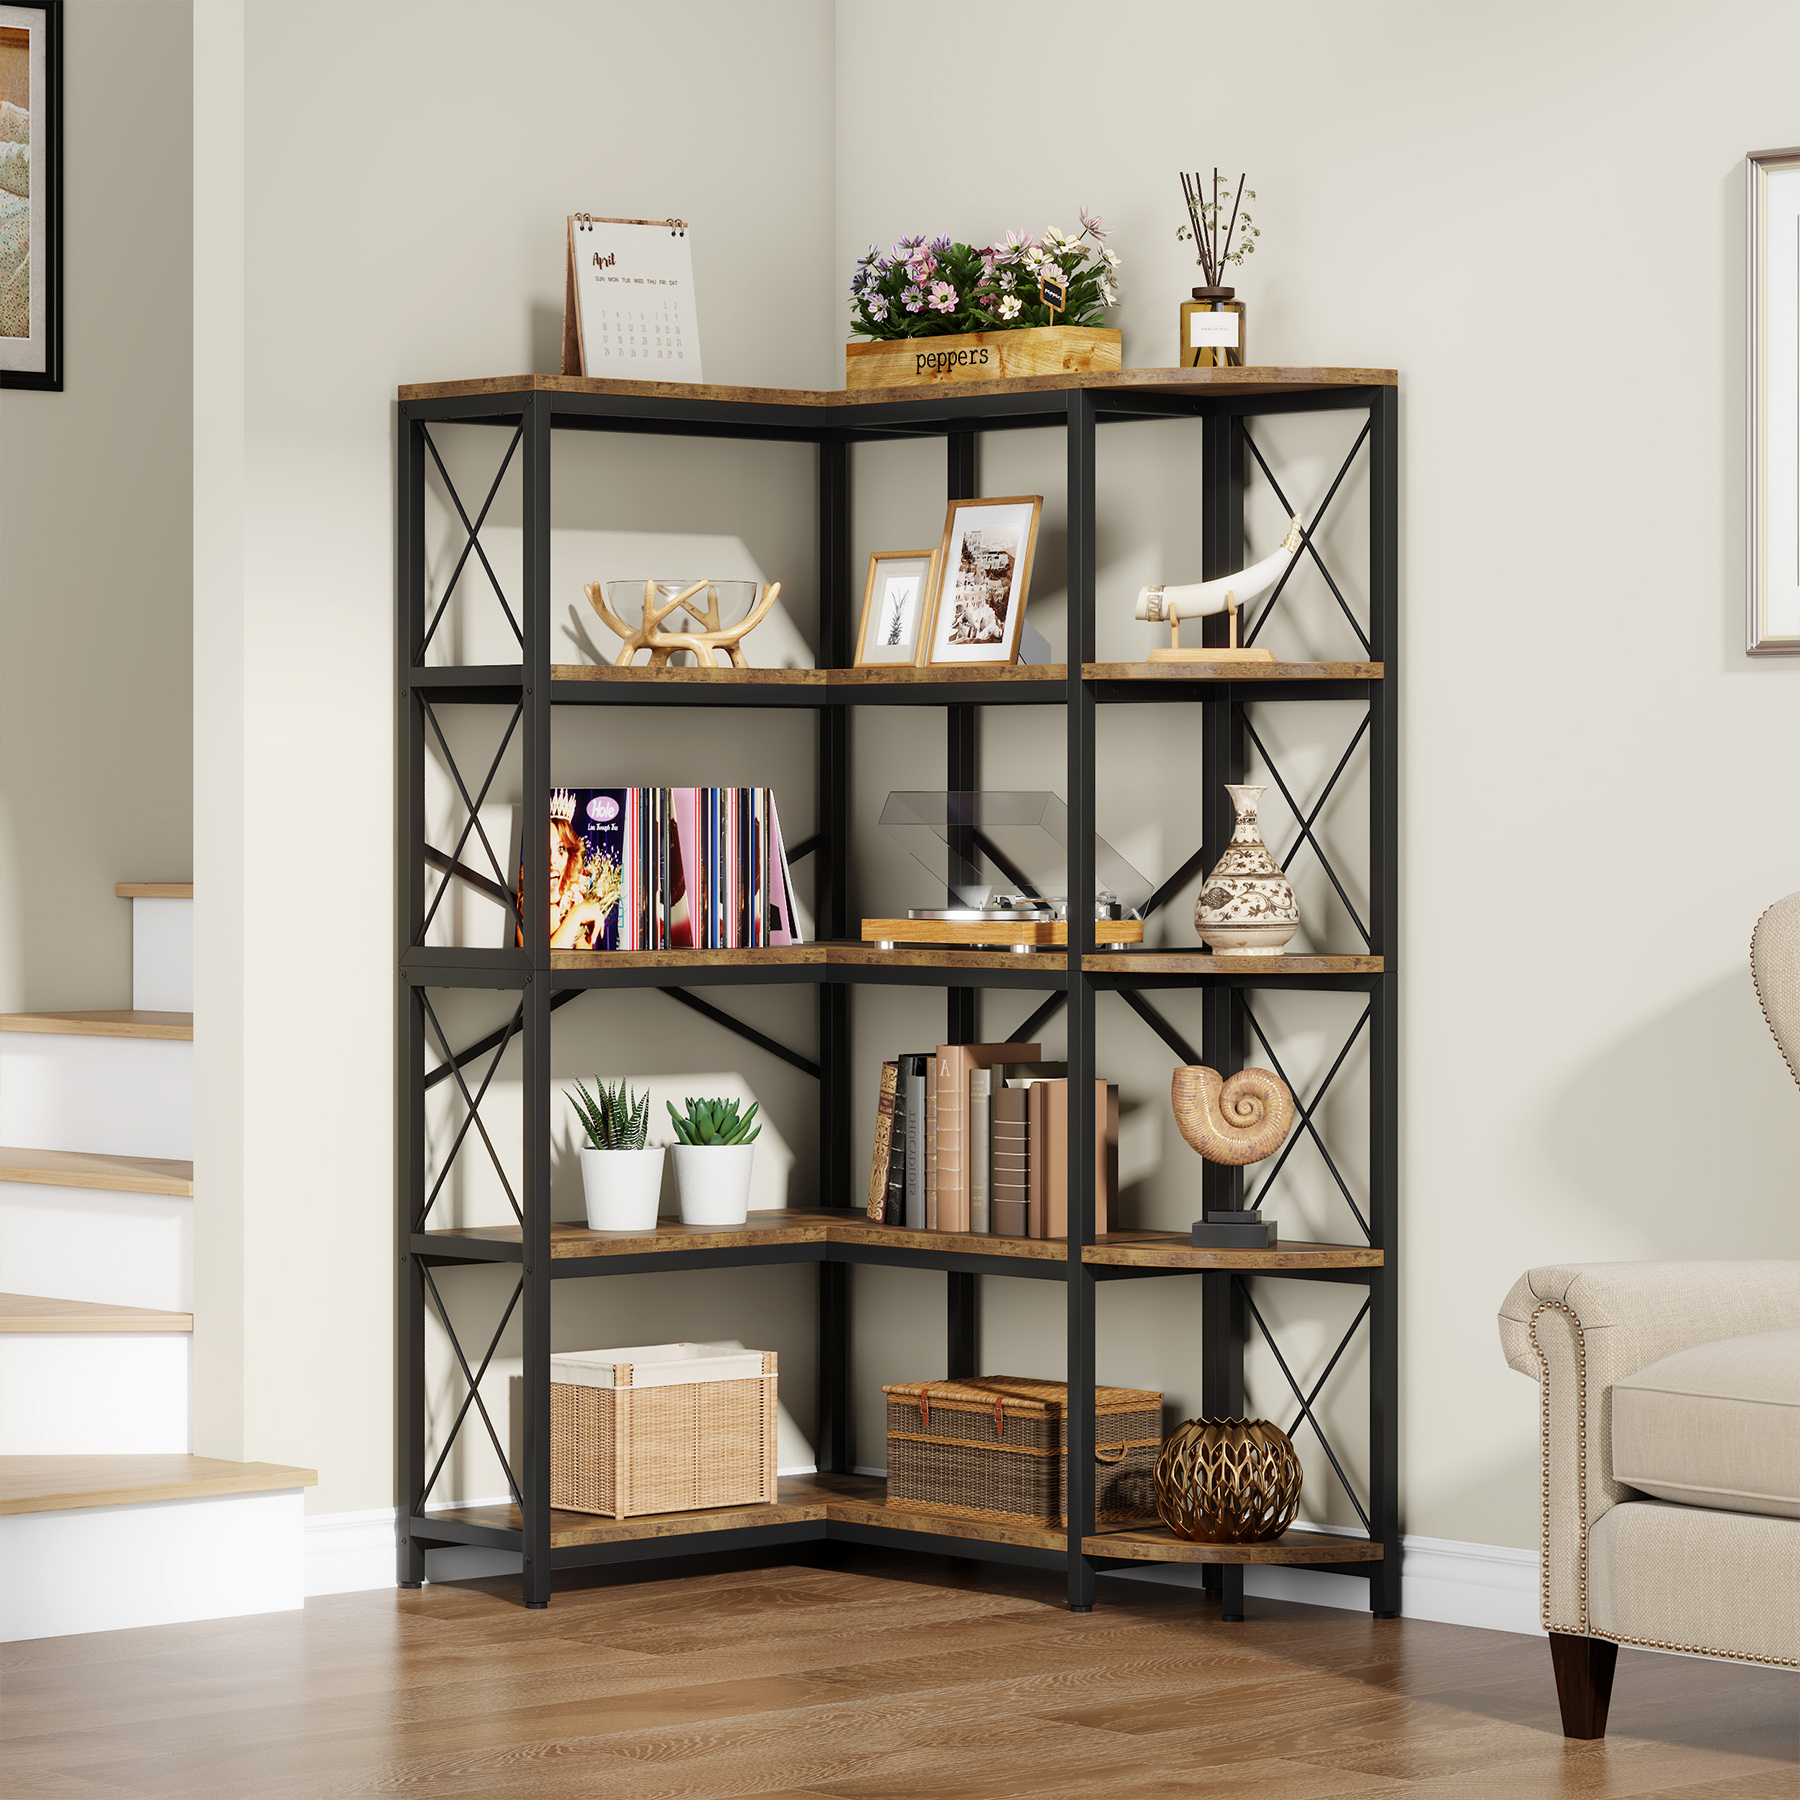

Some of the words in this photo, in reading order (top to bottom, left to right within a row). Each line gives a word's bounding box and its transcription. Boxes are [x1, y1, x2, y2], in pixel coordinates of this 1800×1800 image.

[592, 252, 617, 270] April
[916, 348, 989, 375] peppers
[591, 799, 615, 818] Hole
[940, 1059, 951, 1077] A
